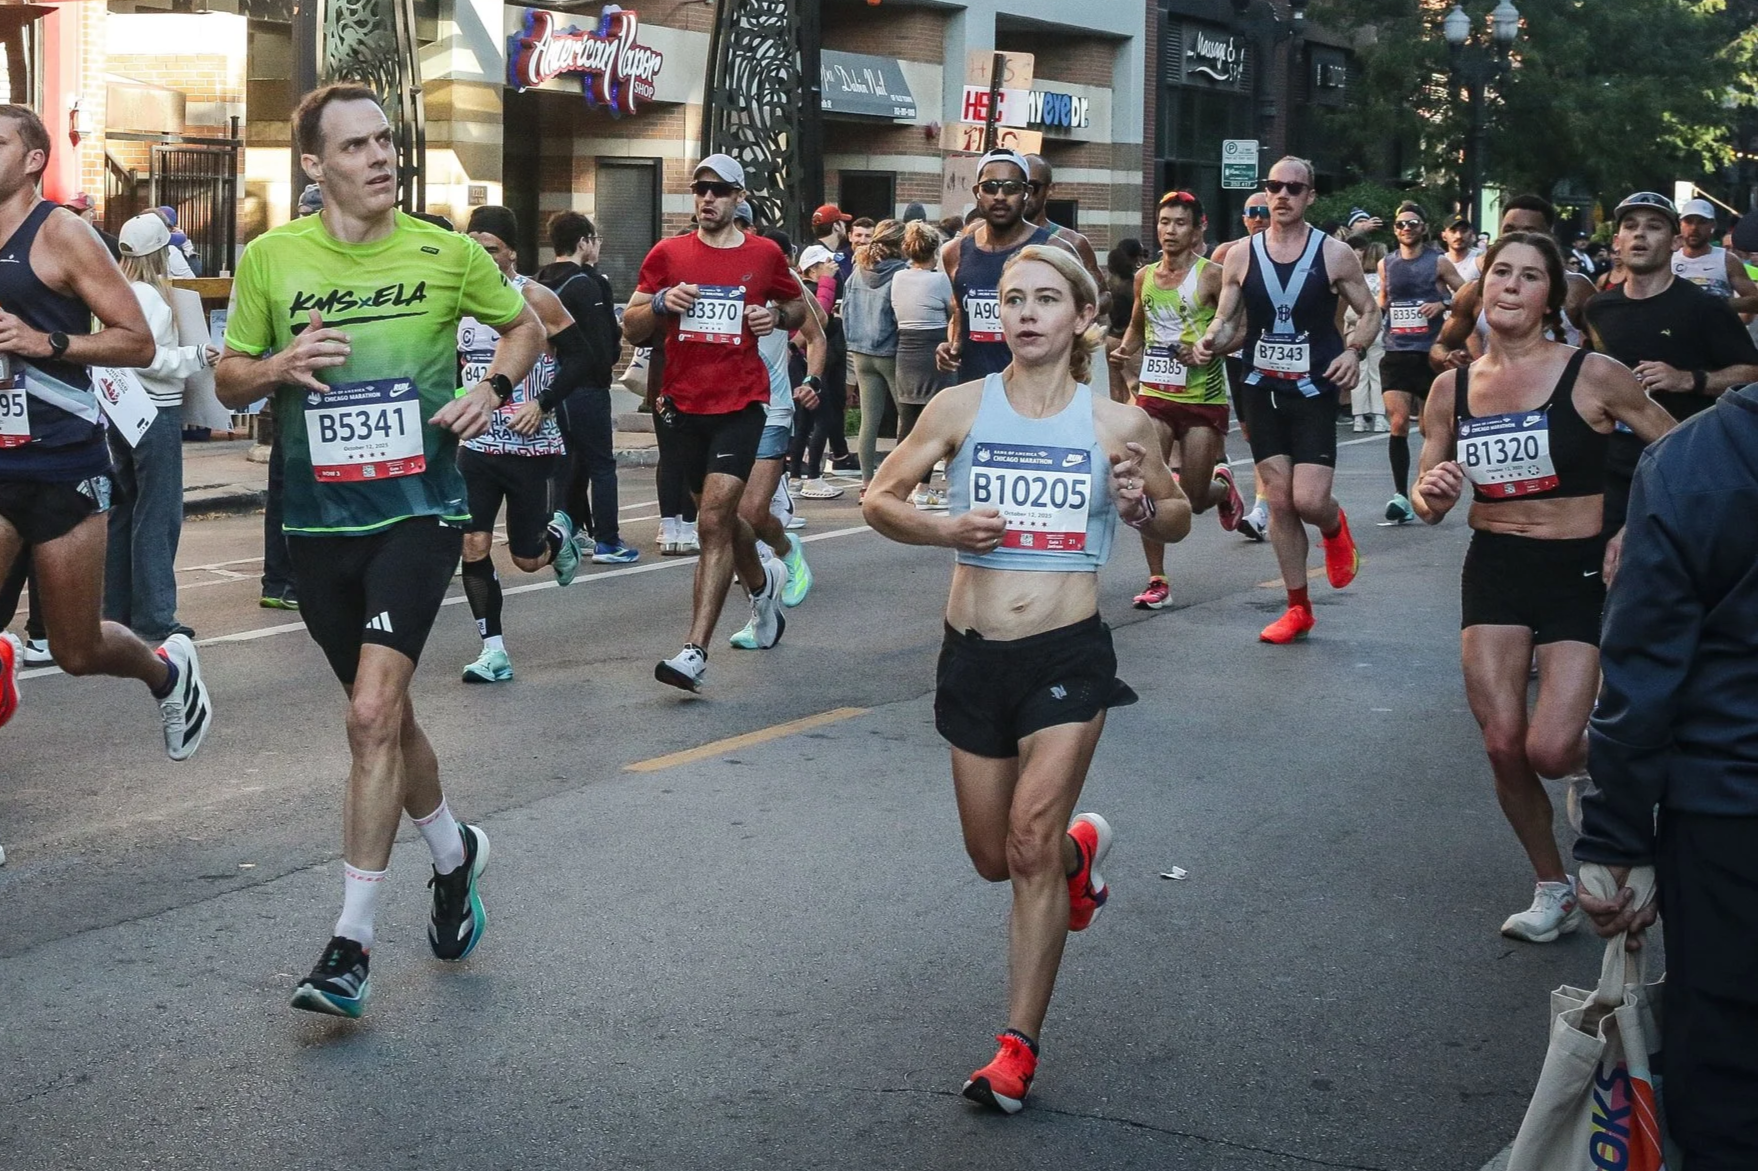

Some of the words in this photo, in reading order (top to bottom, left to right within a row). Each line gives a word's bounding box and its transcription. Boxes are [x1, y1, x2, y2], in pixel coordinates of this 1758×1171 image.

[528, 14, 619, 101] American
[617, 14, 662, 113] Vapor
[633, 81, 653, 98] SHOP
[863, 68, 888, 97] Nail
[686, 301, 738, 320] B3370
[1259, 345, 1303, 361] B7343
[1147, 359, 1182, 375] B5385
[349, 392, 381, 400] MARATHON
[318, 407, 405, 443] B5341
[993, 455, 1019, 463] CHICAGO
[1019, 457, 1053, 465] MARATHON
[1066, 453, 1084, 463] RUN
[1465, 435, 1539, 468] B1320
[973, 472, 1087, 510] B10205
[1028, 510, 1037, 518] 12,
